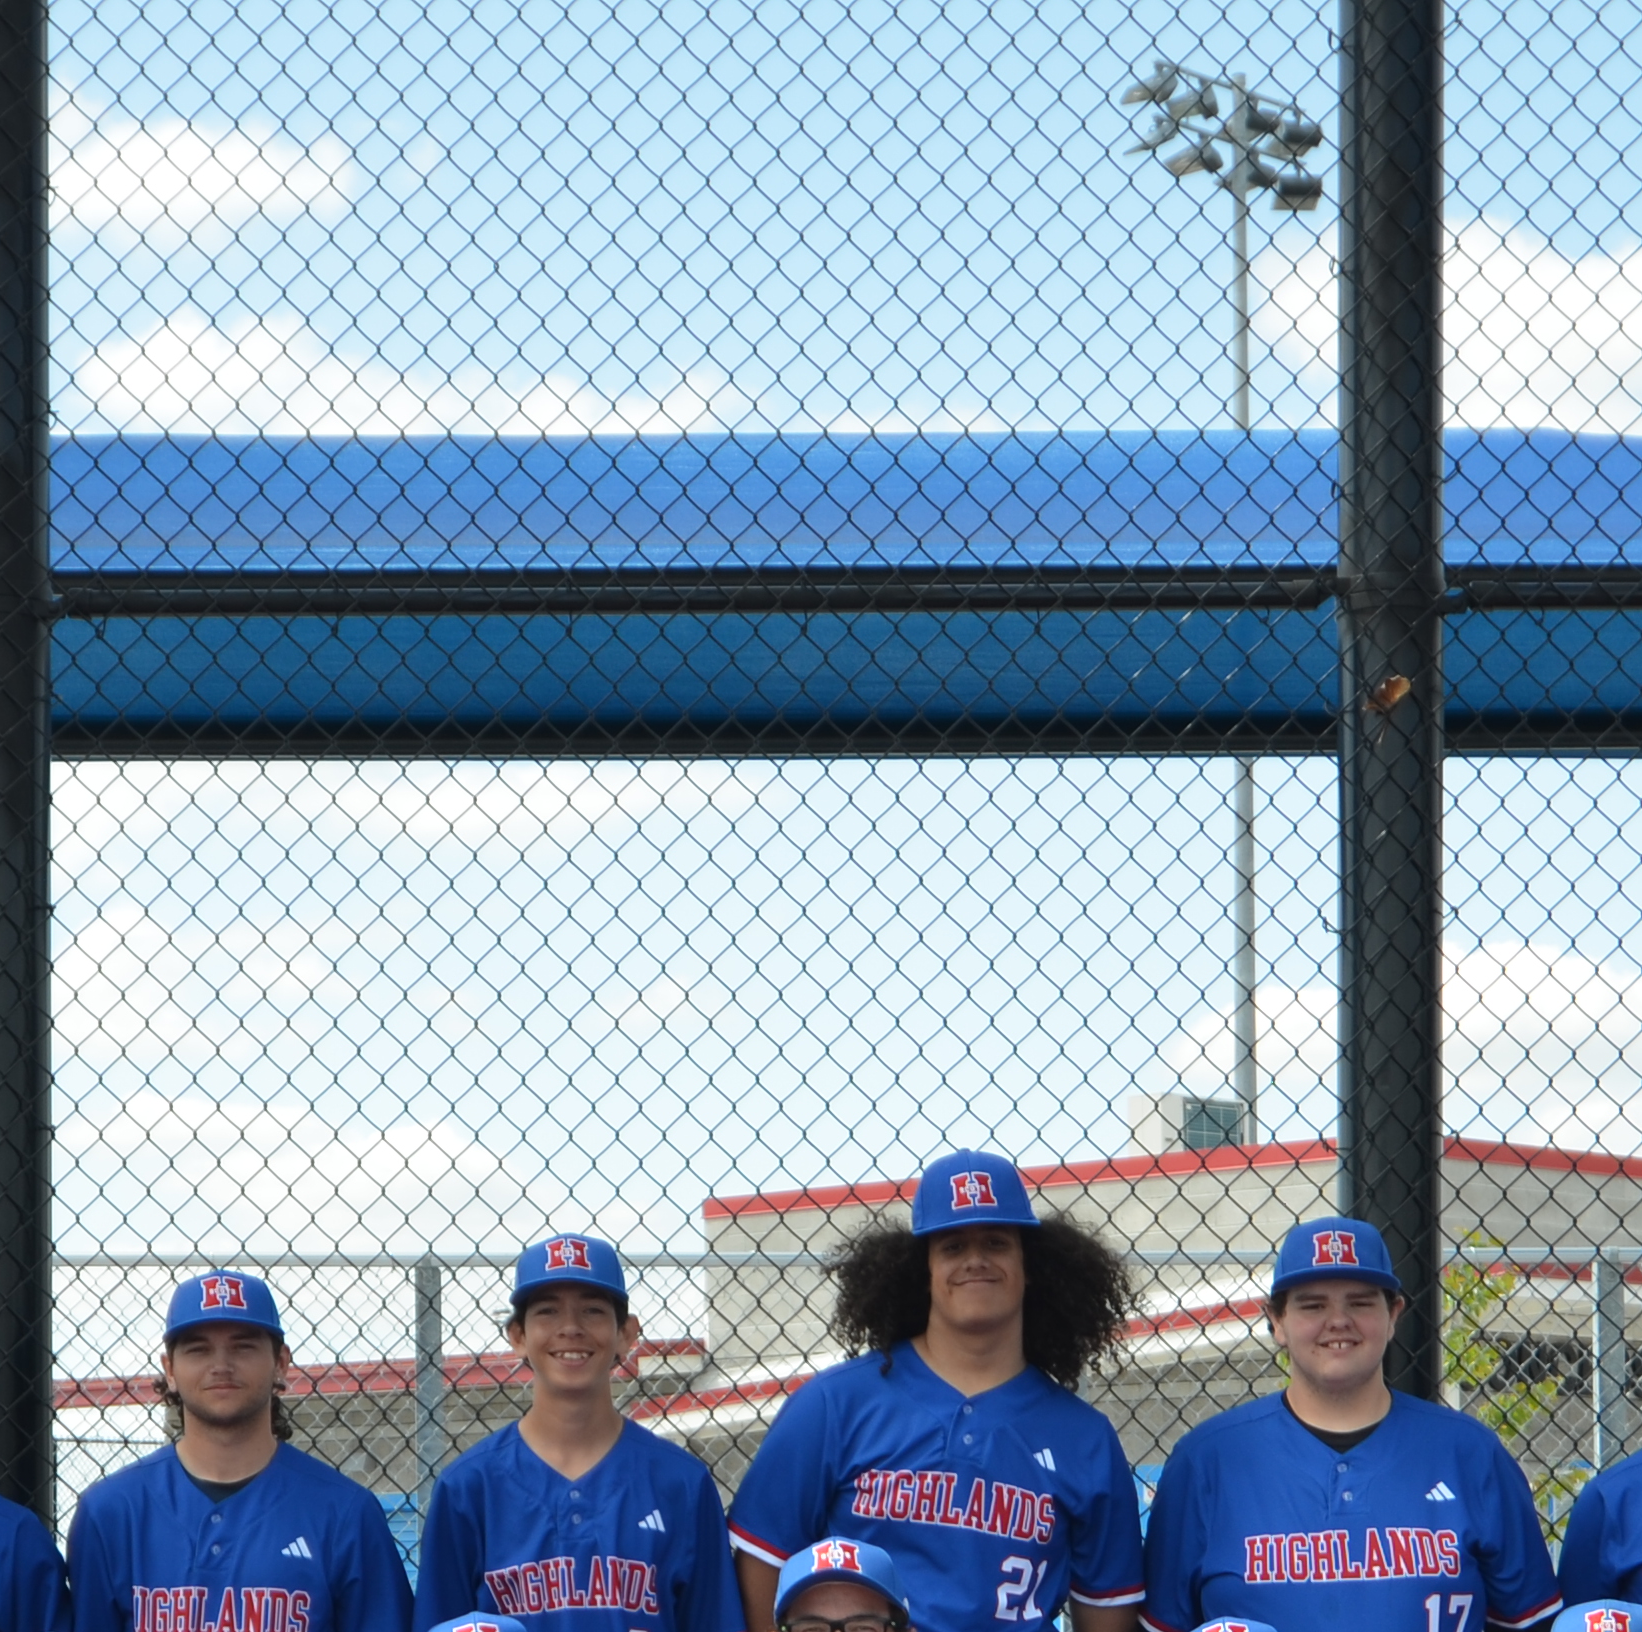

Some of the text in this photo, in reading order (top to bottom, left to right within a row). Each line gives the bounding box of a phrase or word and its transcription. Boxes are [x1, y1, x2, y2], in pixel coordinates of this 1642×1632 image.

[950, 1171, 998, 1210] H
[545, 1237, 592, 1272] H
[1312, 1231, 1359, 1266] H
[200, 1276, 247, 1311] H
[851, 1469, 1056, 1546] HIGHLANDS
[812, 1540, 862, 1572] H
[1244, 1527, 1462, 1584] HIGHLANDS
[484, 1556, 660, 1616] HIGHLANDS
[994, 1554, 1048, 1622] 21
